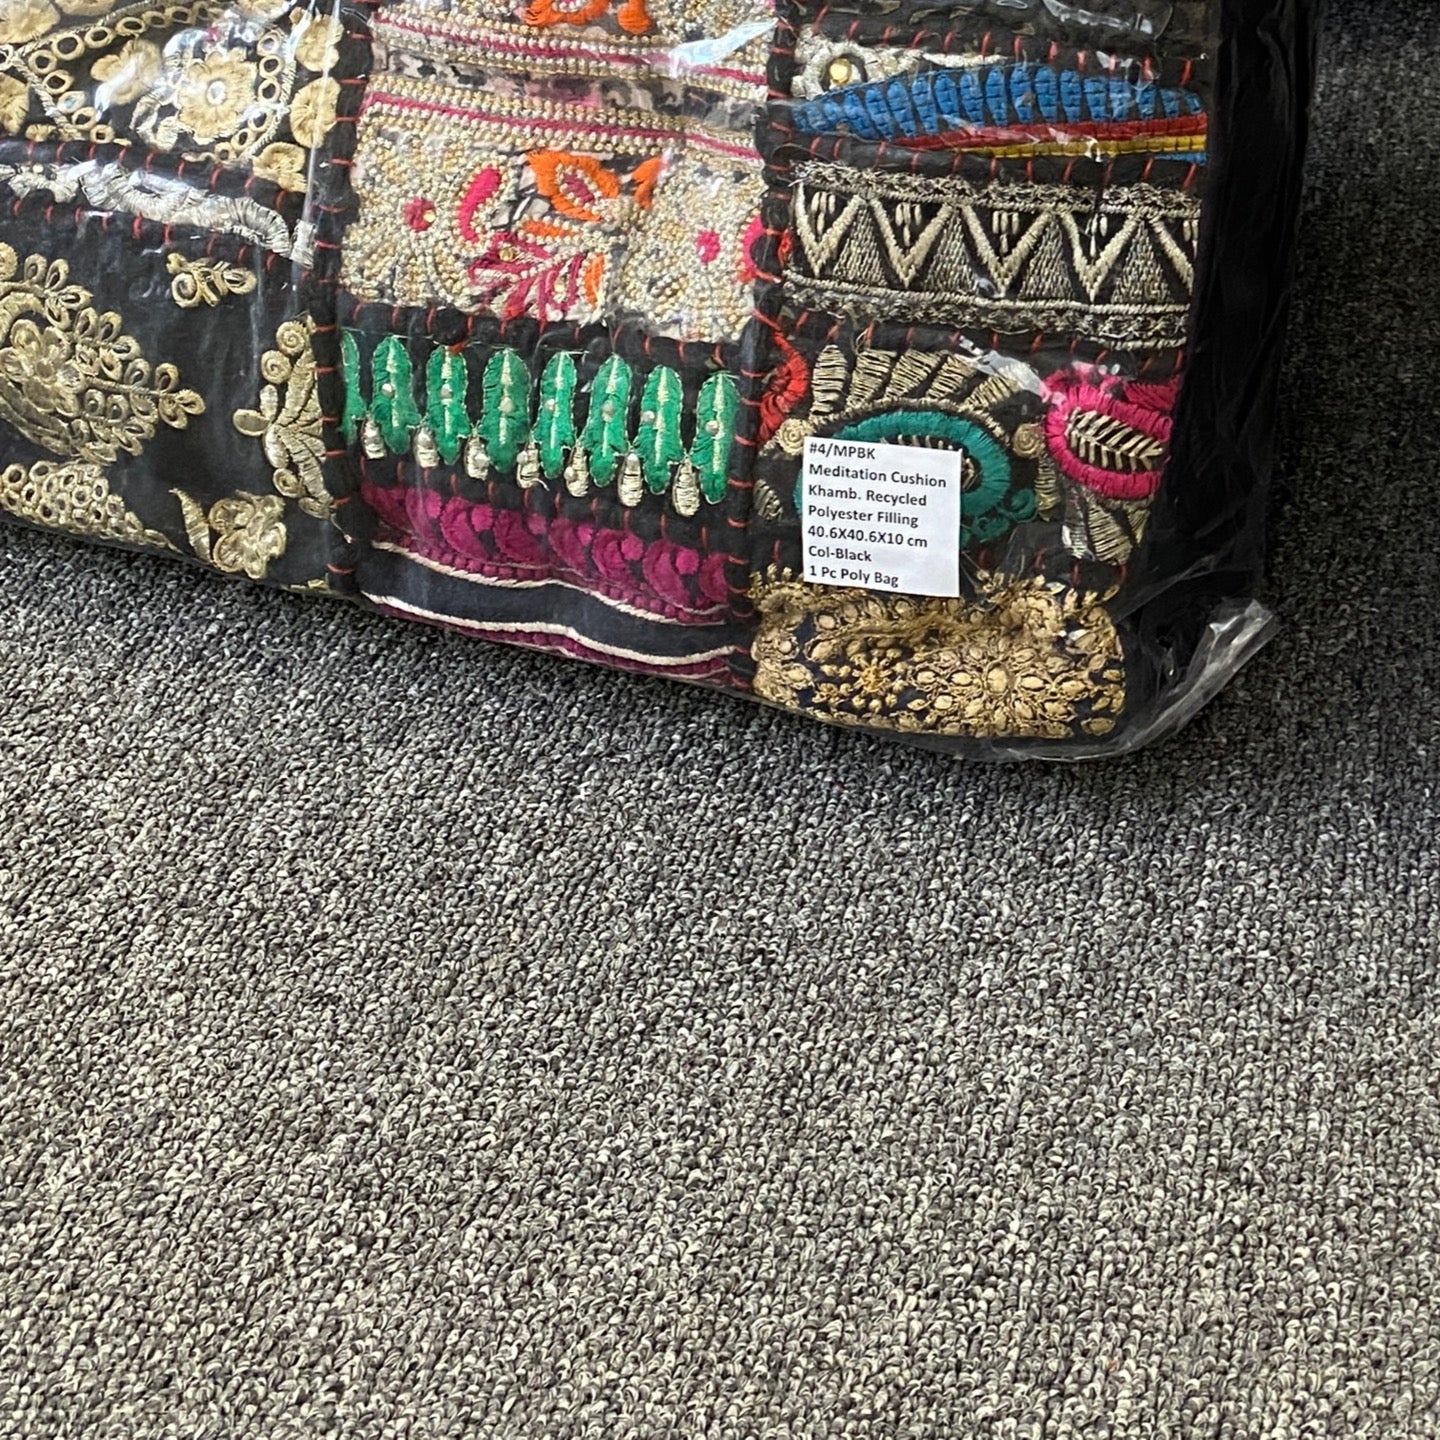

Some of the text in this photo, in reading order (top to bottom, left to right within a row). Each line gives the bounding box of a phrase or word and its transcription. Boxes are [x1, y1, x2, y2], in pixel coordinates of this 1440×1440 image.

[809, 442, 876, 460] #4/MPBK
[809, 463, 947, 488] Meditation Cushion
[808, 484, 927, 507] Khamb. Recycled
[808, 505, 919, 528] Polyester Filling
[808, 525, 928, 547] 40.6X40.6X10 cm
[808, 545, 872, 562] Col-Black
[810, 565, 899, 588] 1 Pc Poly Bag
